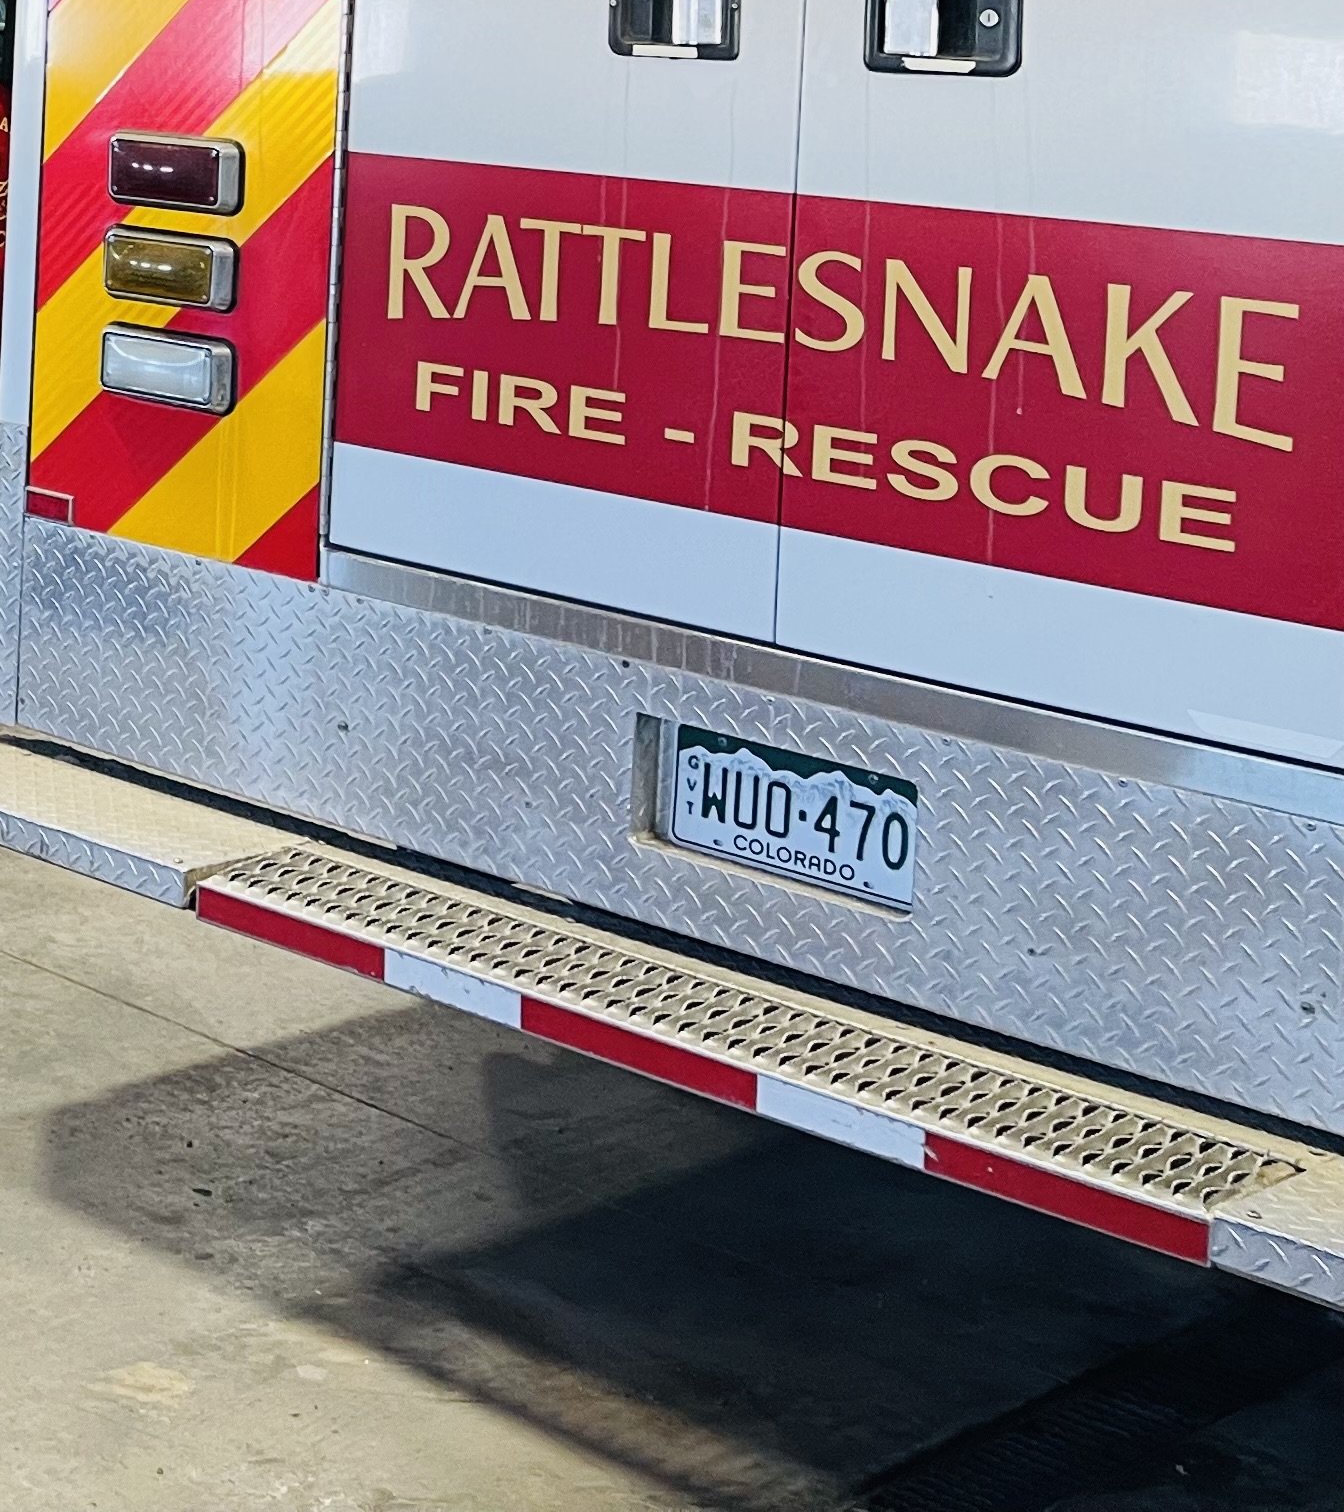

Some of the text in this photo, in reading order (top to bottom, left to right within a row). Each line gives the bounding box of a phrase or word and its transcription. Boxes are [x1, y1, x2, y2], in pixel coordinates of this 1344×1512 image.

[387, 203, 1301, 453] RATTLESNAKE
[415, 360, 627, 447] FIRE
[730, 410, 1238, 555] RESCUE
[733, 834, 856, 881] COLORADO
